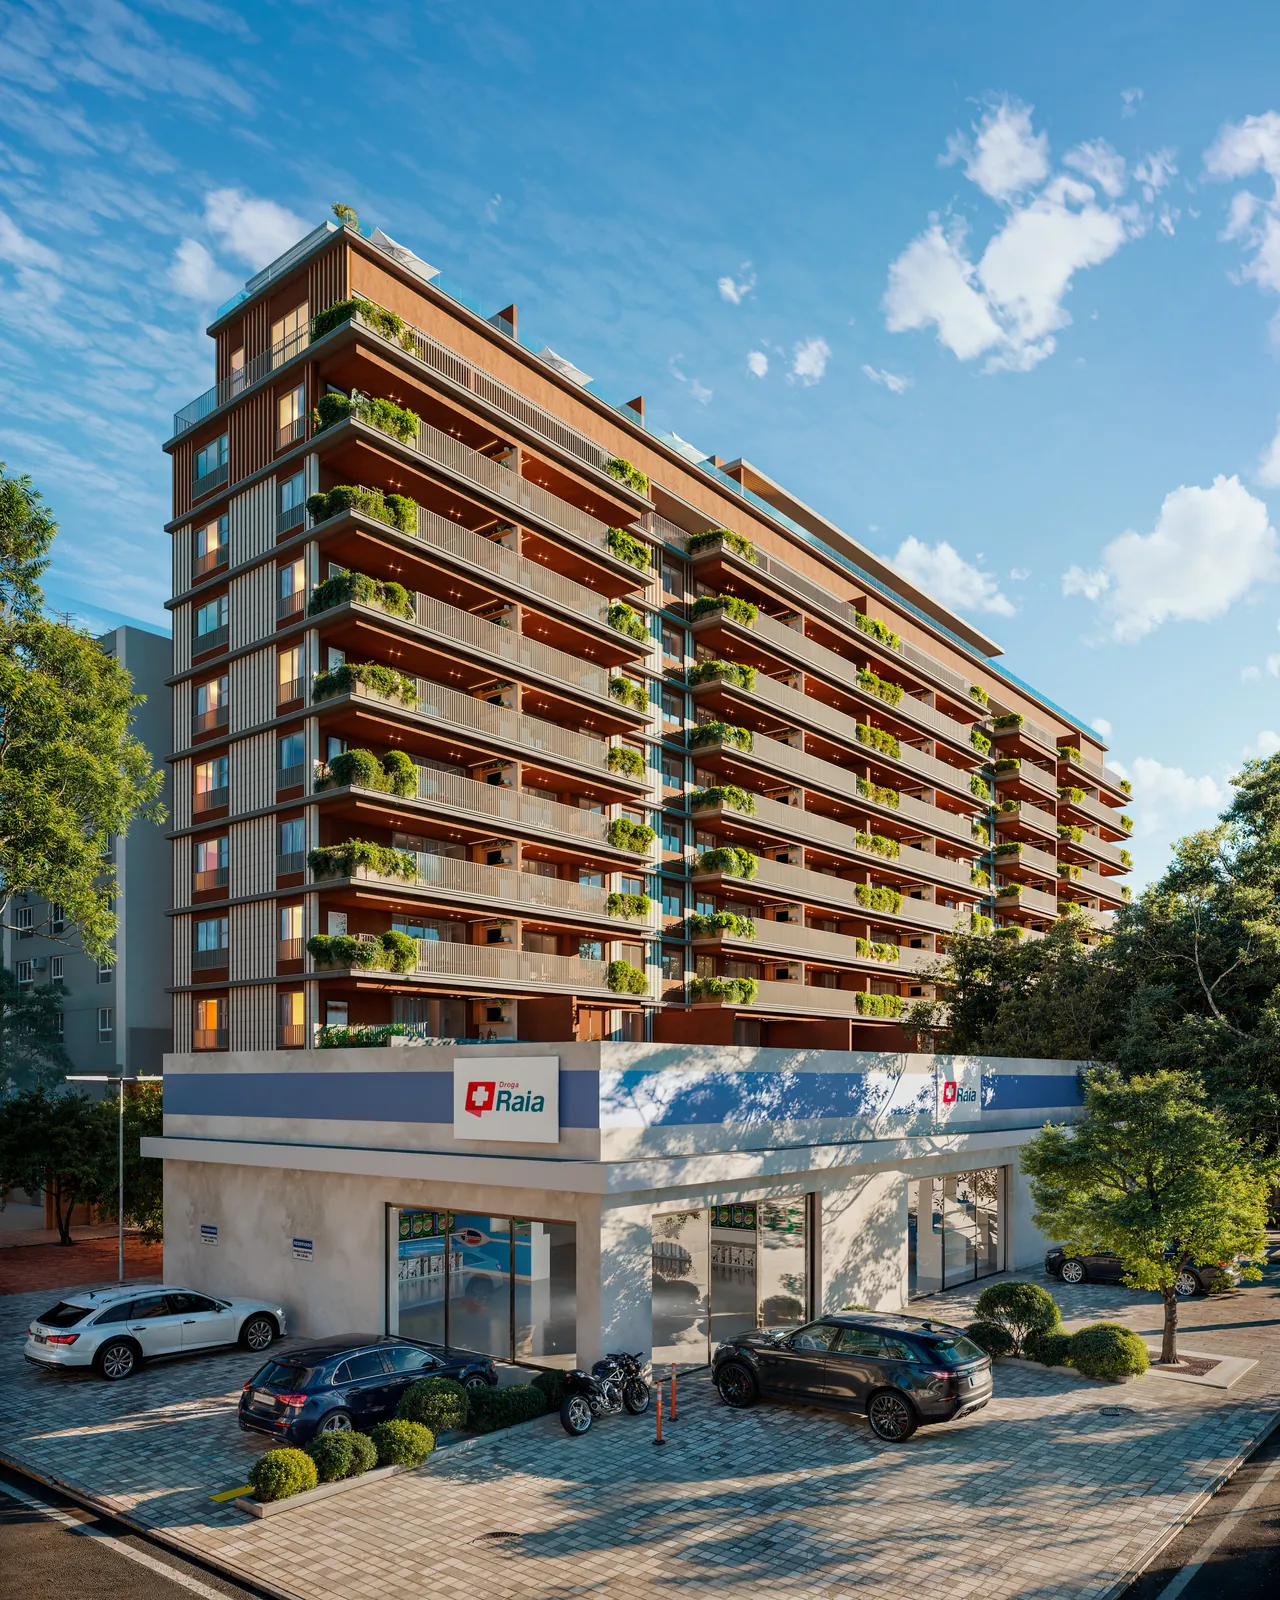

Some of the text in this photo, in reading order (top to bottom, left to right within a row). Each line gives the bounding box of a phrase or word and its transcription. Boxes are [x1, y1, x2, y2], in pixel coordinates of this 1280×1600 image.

[499, 1081, 519, 1089] Droga
[496, 1090, 545, 1112] Raia
[956, 1087, 977, 1102] Raia
